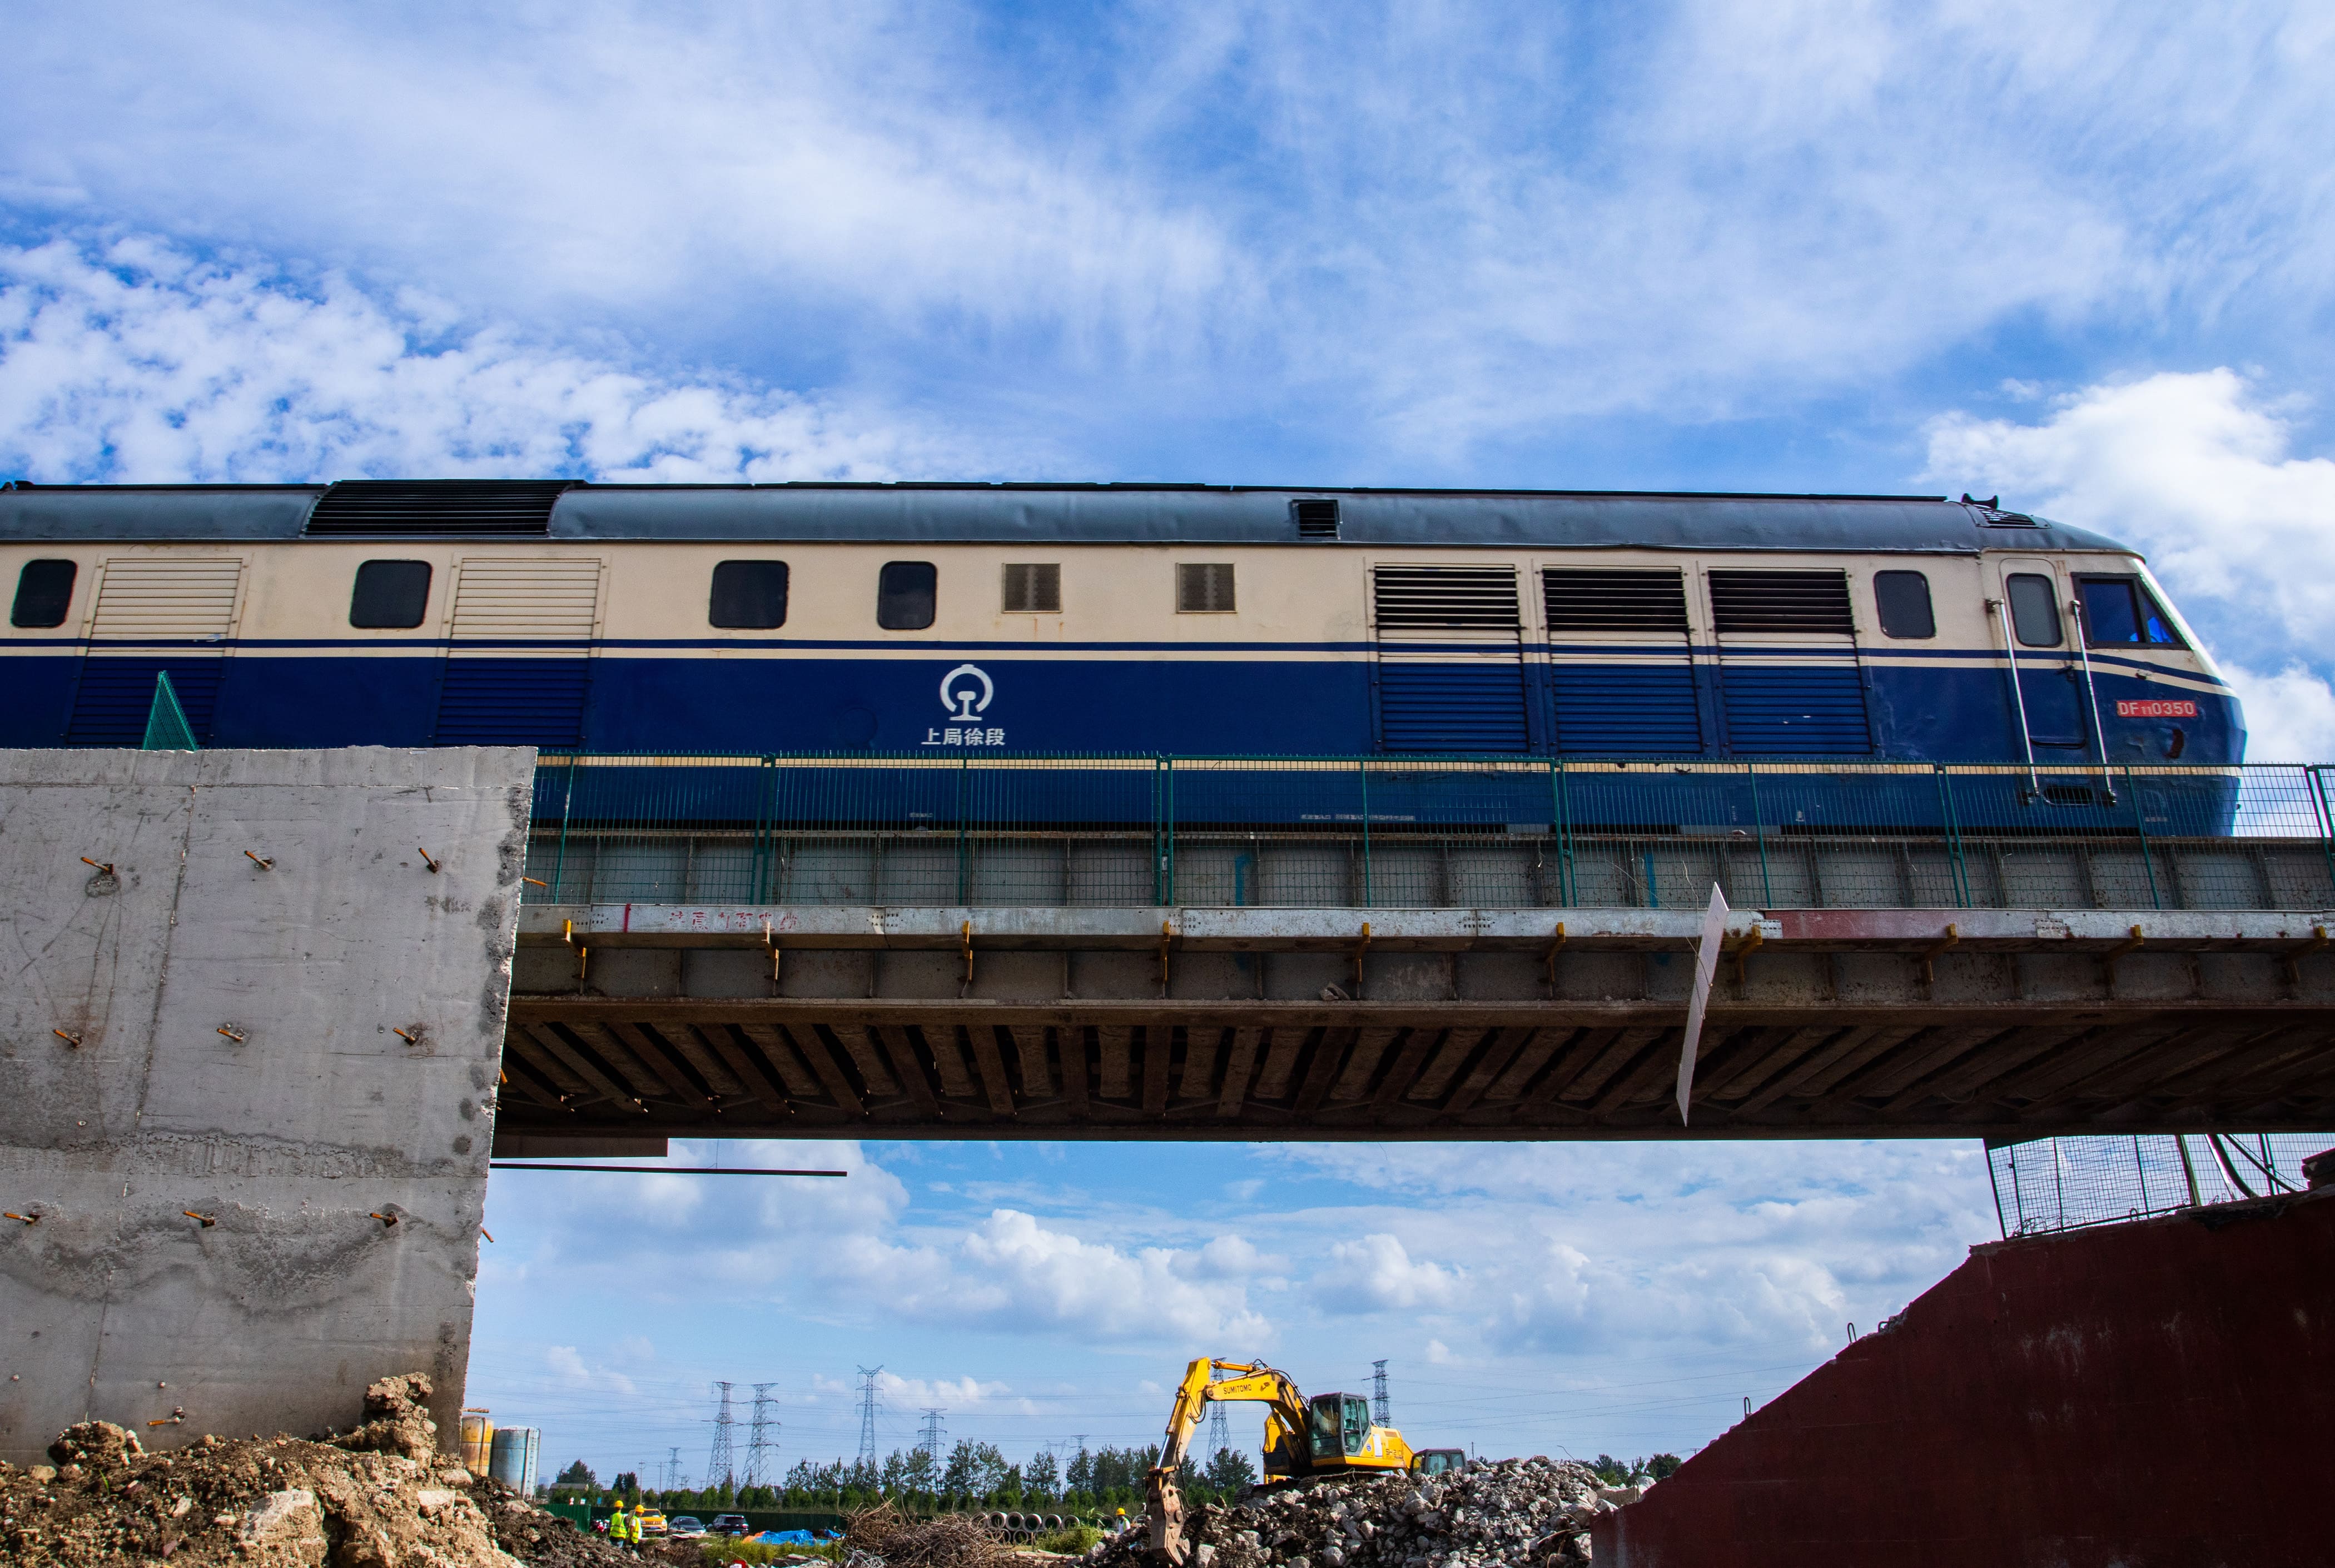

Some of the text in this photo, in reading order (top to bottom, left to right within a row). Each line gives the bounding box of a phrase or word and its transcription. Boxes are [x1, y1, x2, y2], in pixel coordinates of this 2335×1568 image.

[921, 728, 1006, 746] 上局徐段
[1223, 1383, 1252, 1395] SUMITOMO
